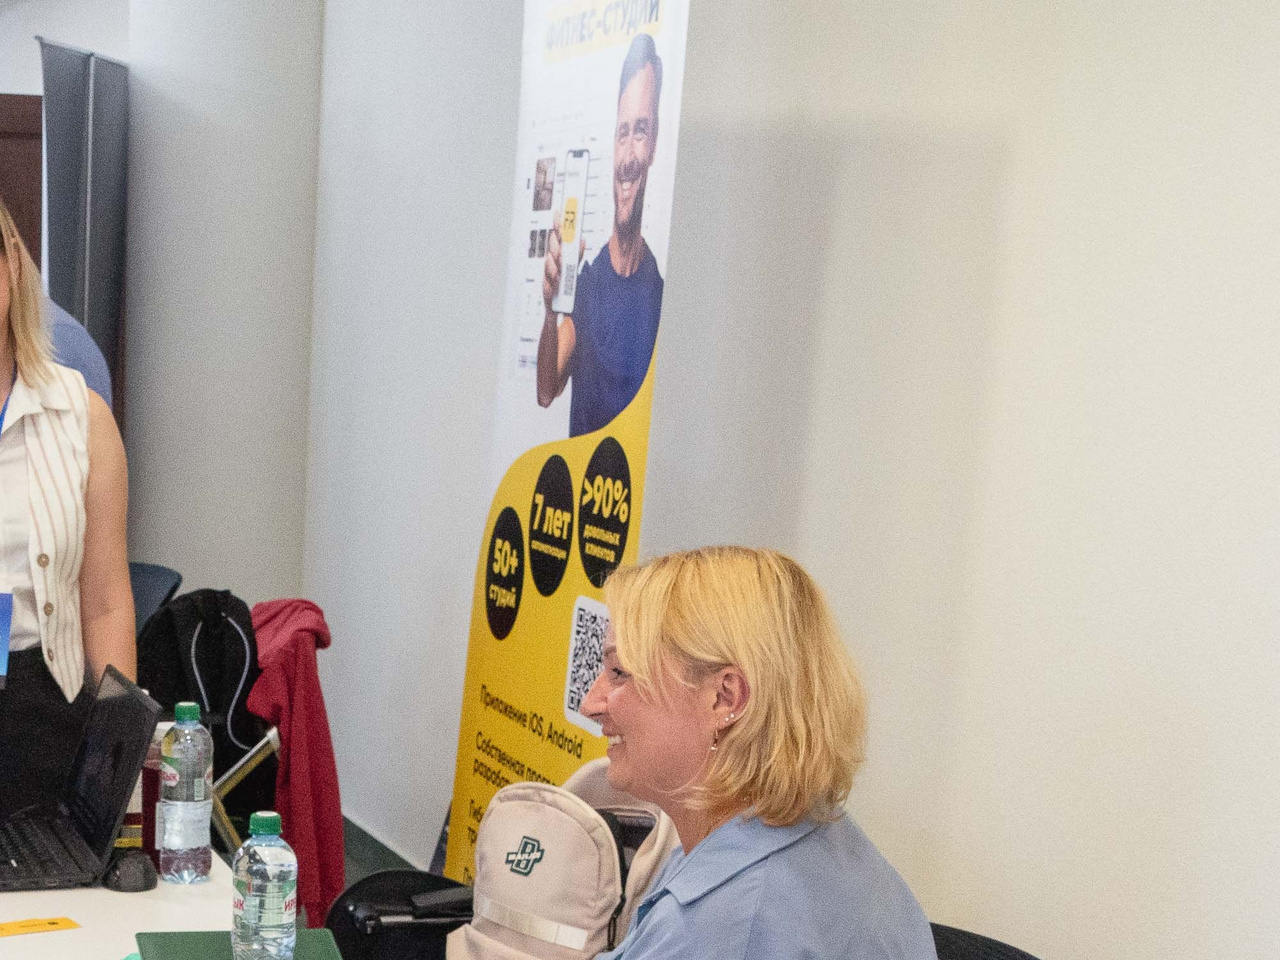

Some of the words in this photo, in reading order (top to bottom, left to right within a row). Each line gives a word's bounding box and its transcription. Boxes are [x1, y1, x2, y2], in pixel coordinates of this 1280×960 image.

[533, 494, 544, 530] 7
[543, 506, 571, 540] лет
[582, 474, 629, 524] >90%
[493, 538, 518, 577] 50+
[480, 684, 527, 728] Приложение
[547, 721, 584, 759] Android
[476, 730, 525, 777] Собственная
